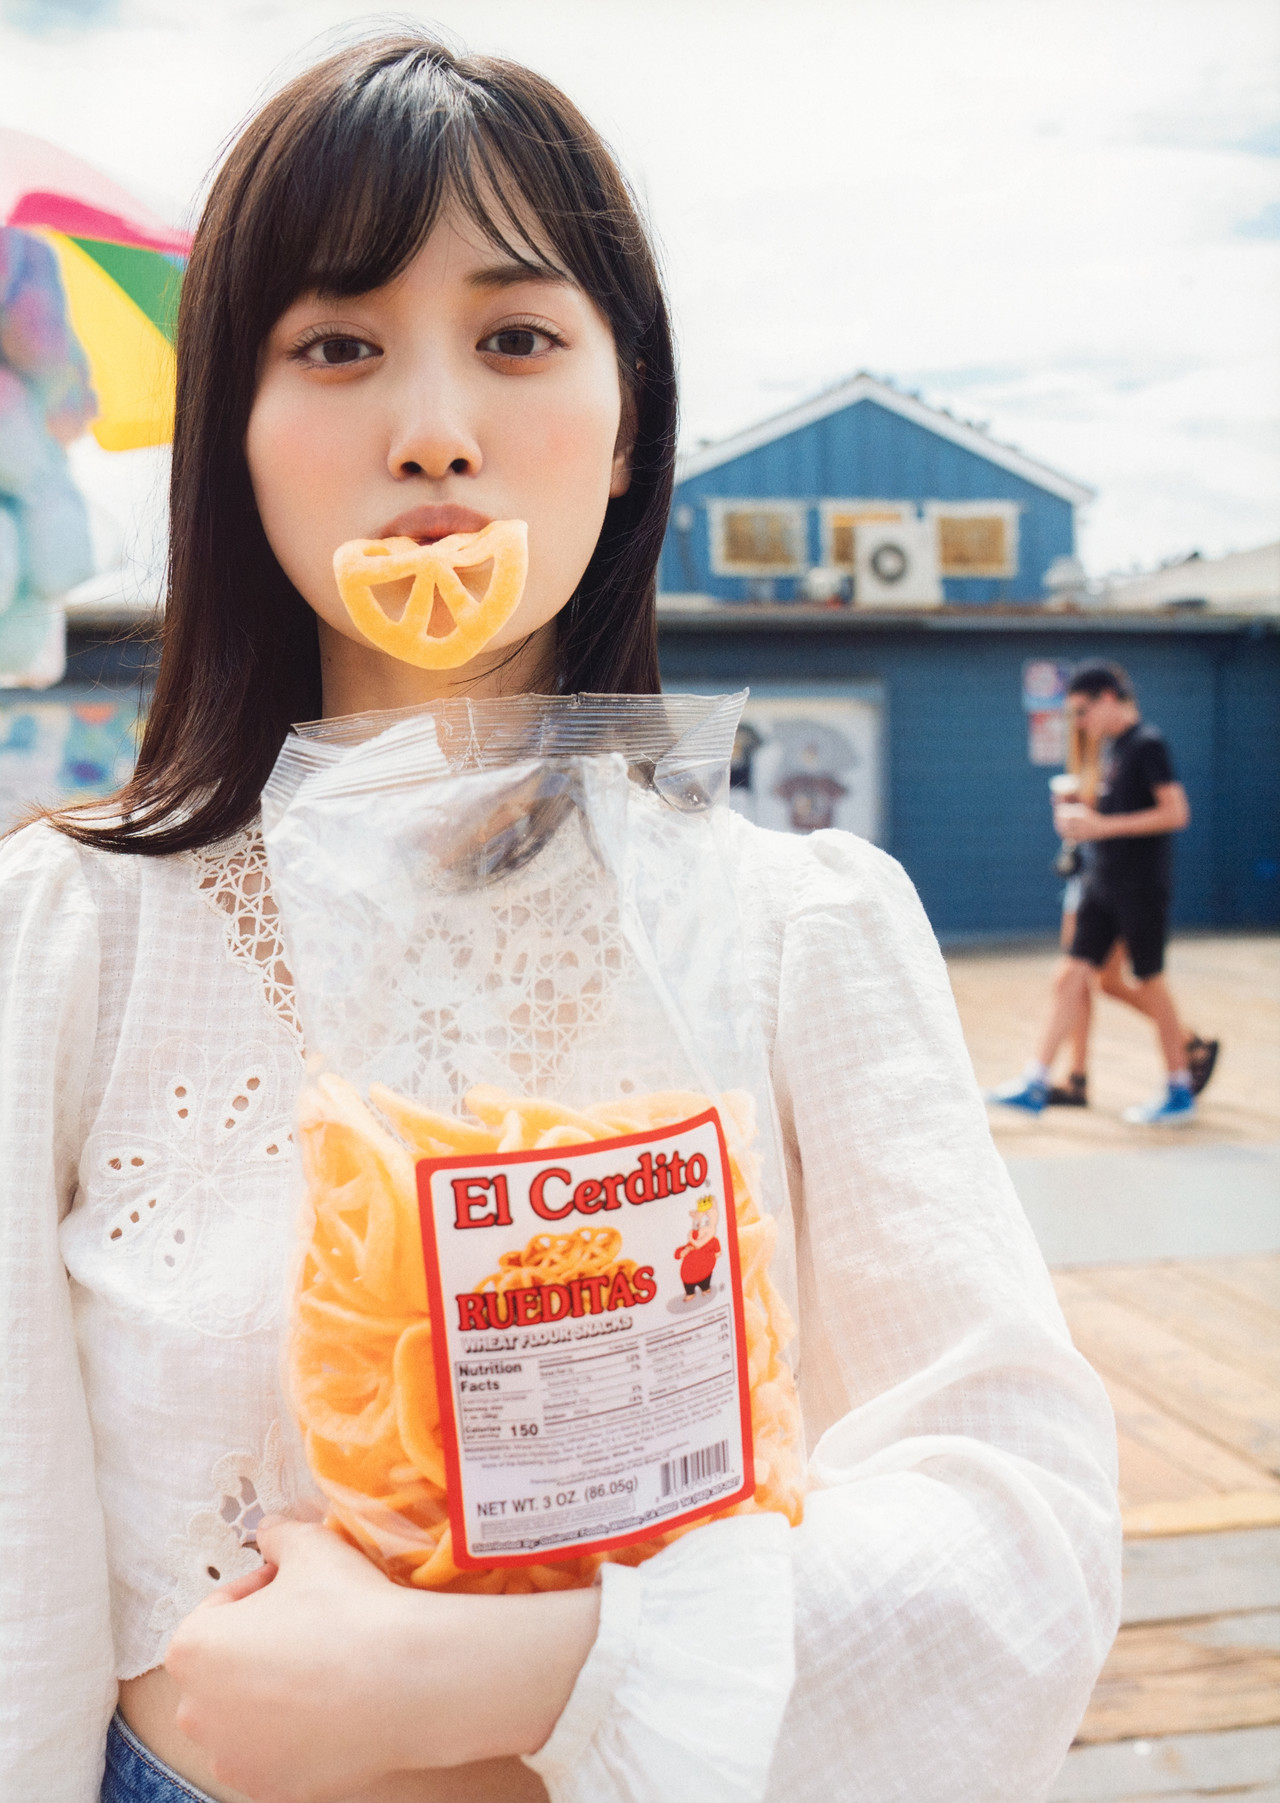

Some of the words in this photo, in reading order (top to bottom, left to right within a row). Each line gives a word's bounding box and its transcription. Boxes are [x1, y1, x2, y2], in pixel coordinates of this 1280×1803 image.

[451, 1174, 513, 1229] El
[529, 1151, 708, 1220] Cerdito
[455, 1266, 657, 1331] RUEDITAS
[463, 1335, 518, 1353] WHEAT
[573, 1316, 632, 1341] SNACKS
[460, 1363, 522, 1376] Nutrition
[460, 1380, 500, 1392] Facts
[511, 1424, 538, 1436] 150
[477, 1501, 507, 1516] NET
[512, 1497, 538, 1513] WT.
[543, 1496, 551, 1509] 3
[584, 1475, 638, 1503] (86.05g)
